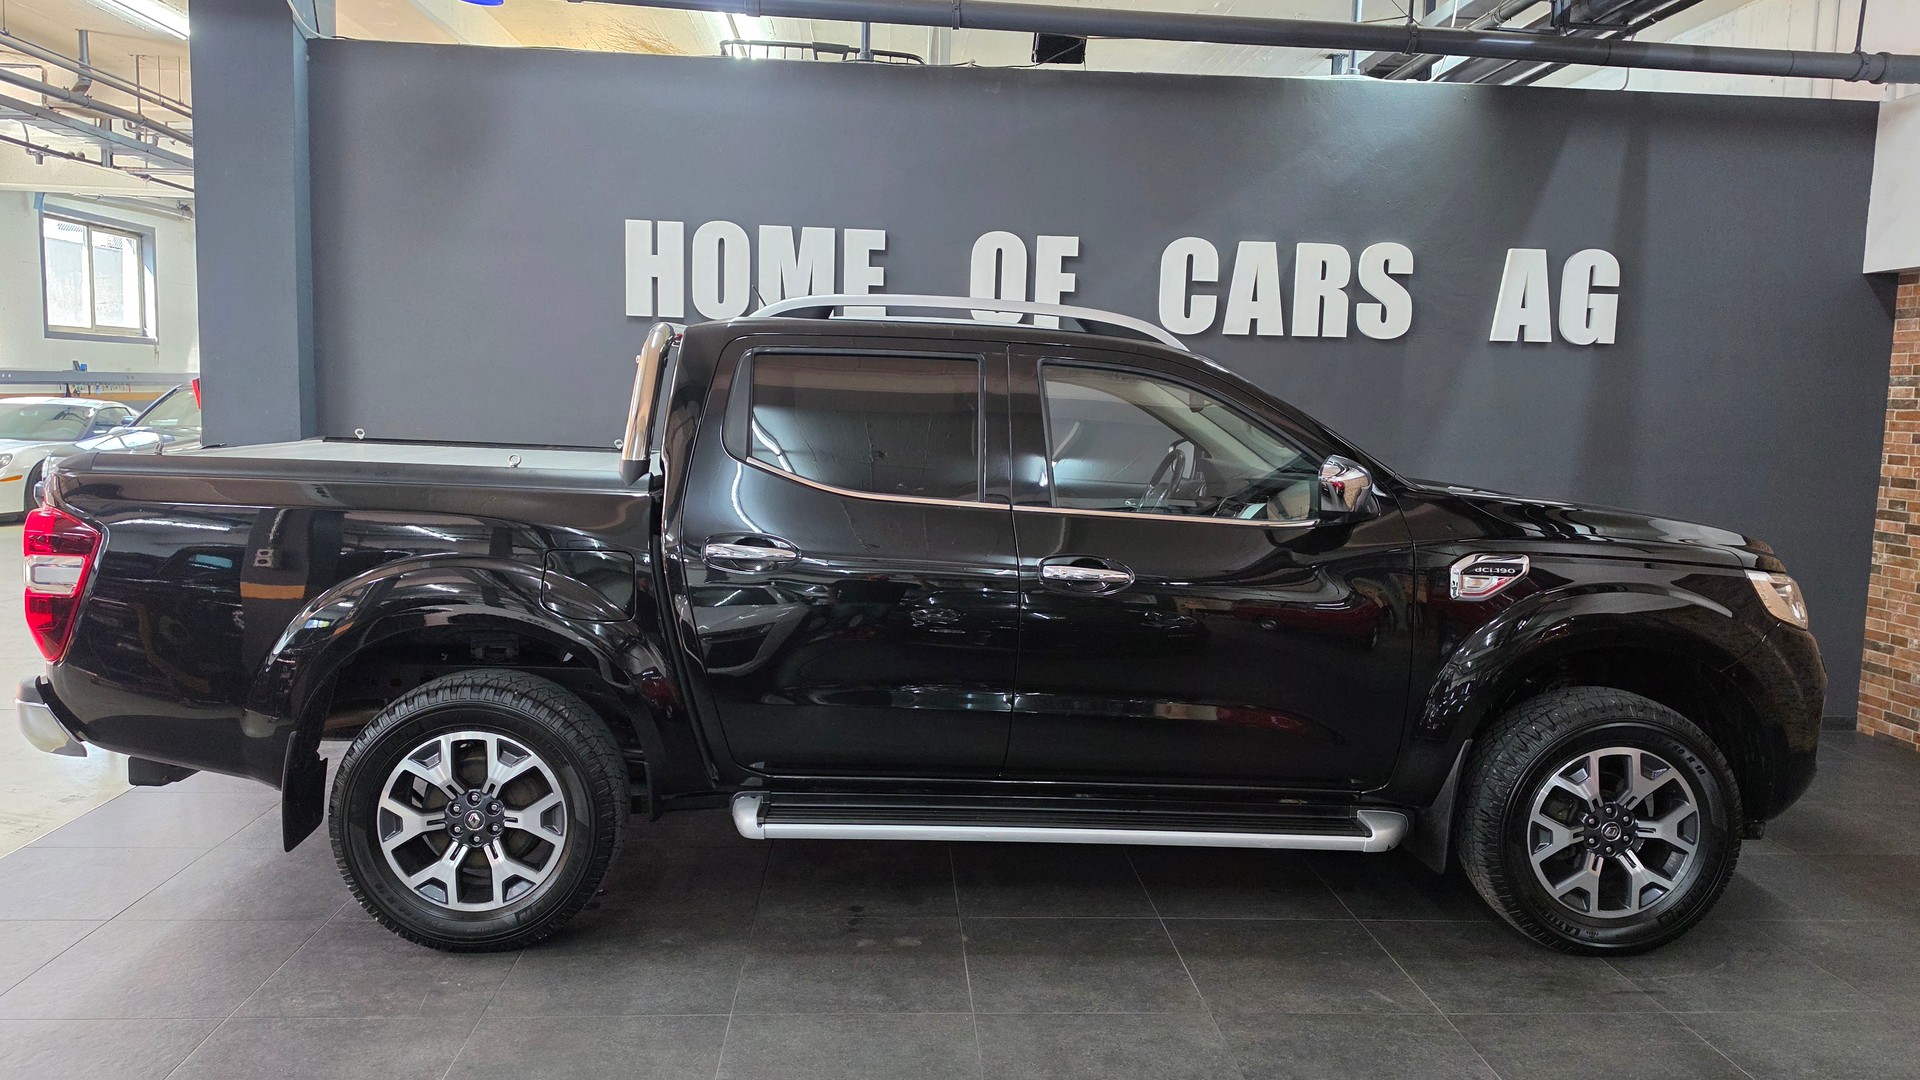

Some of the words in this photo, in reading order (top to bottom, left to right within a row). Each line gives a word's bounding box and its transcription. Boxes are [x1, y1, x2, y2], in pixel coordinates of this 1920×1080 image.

[625, 219, 886, 320] HOME
[969, 230, 1080, 329] OF
[1158, 237, 1414, 340] CARS
[1489, 248, 1620, 345] AG
